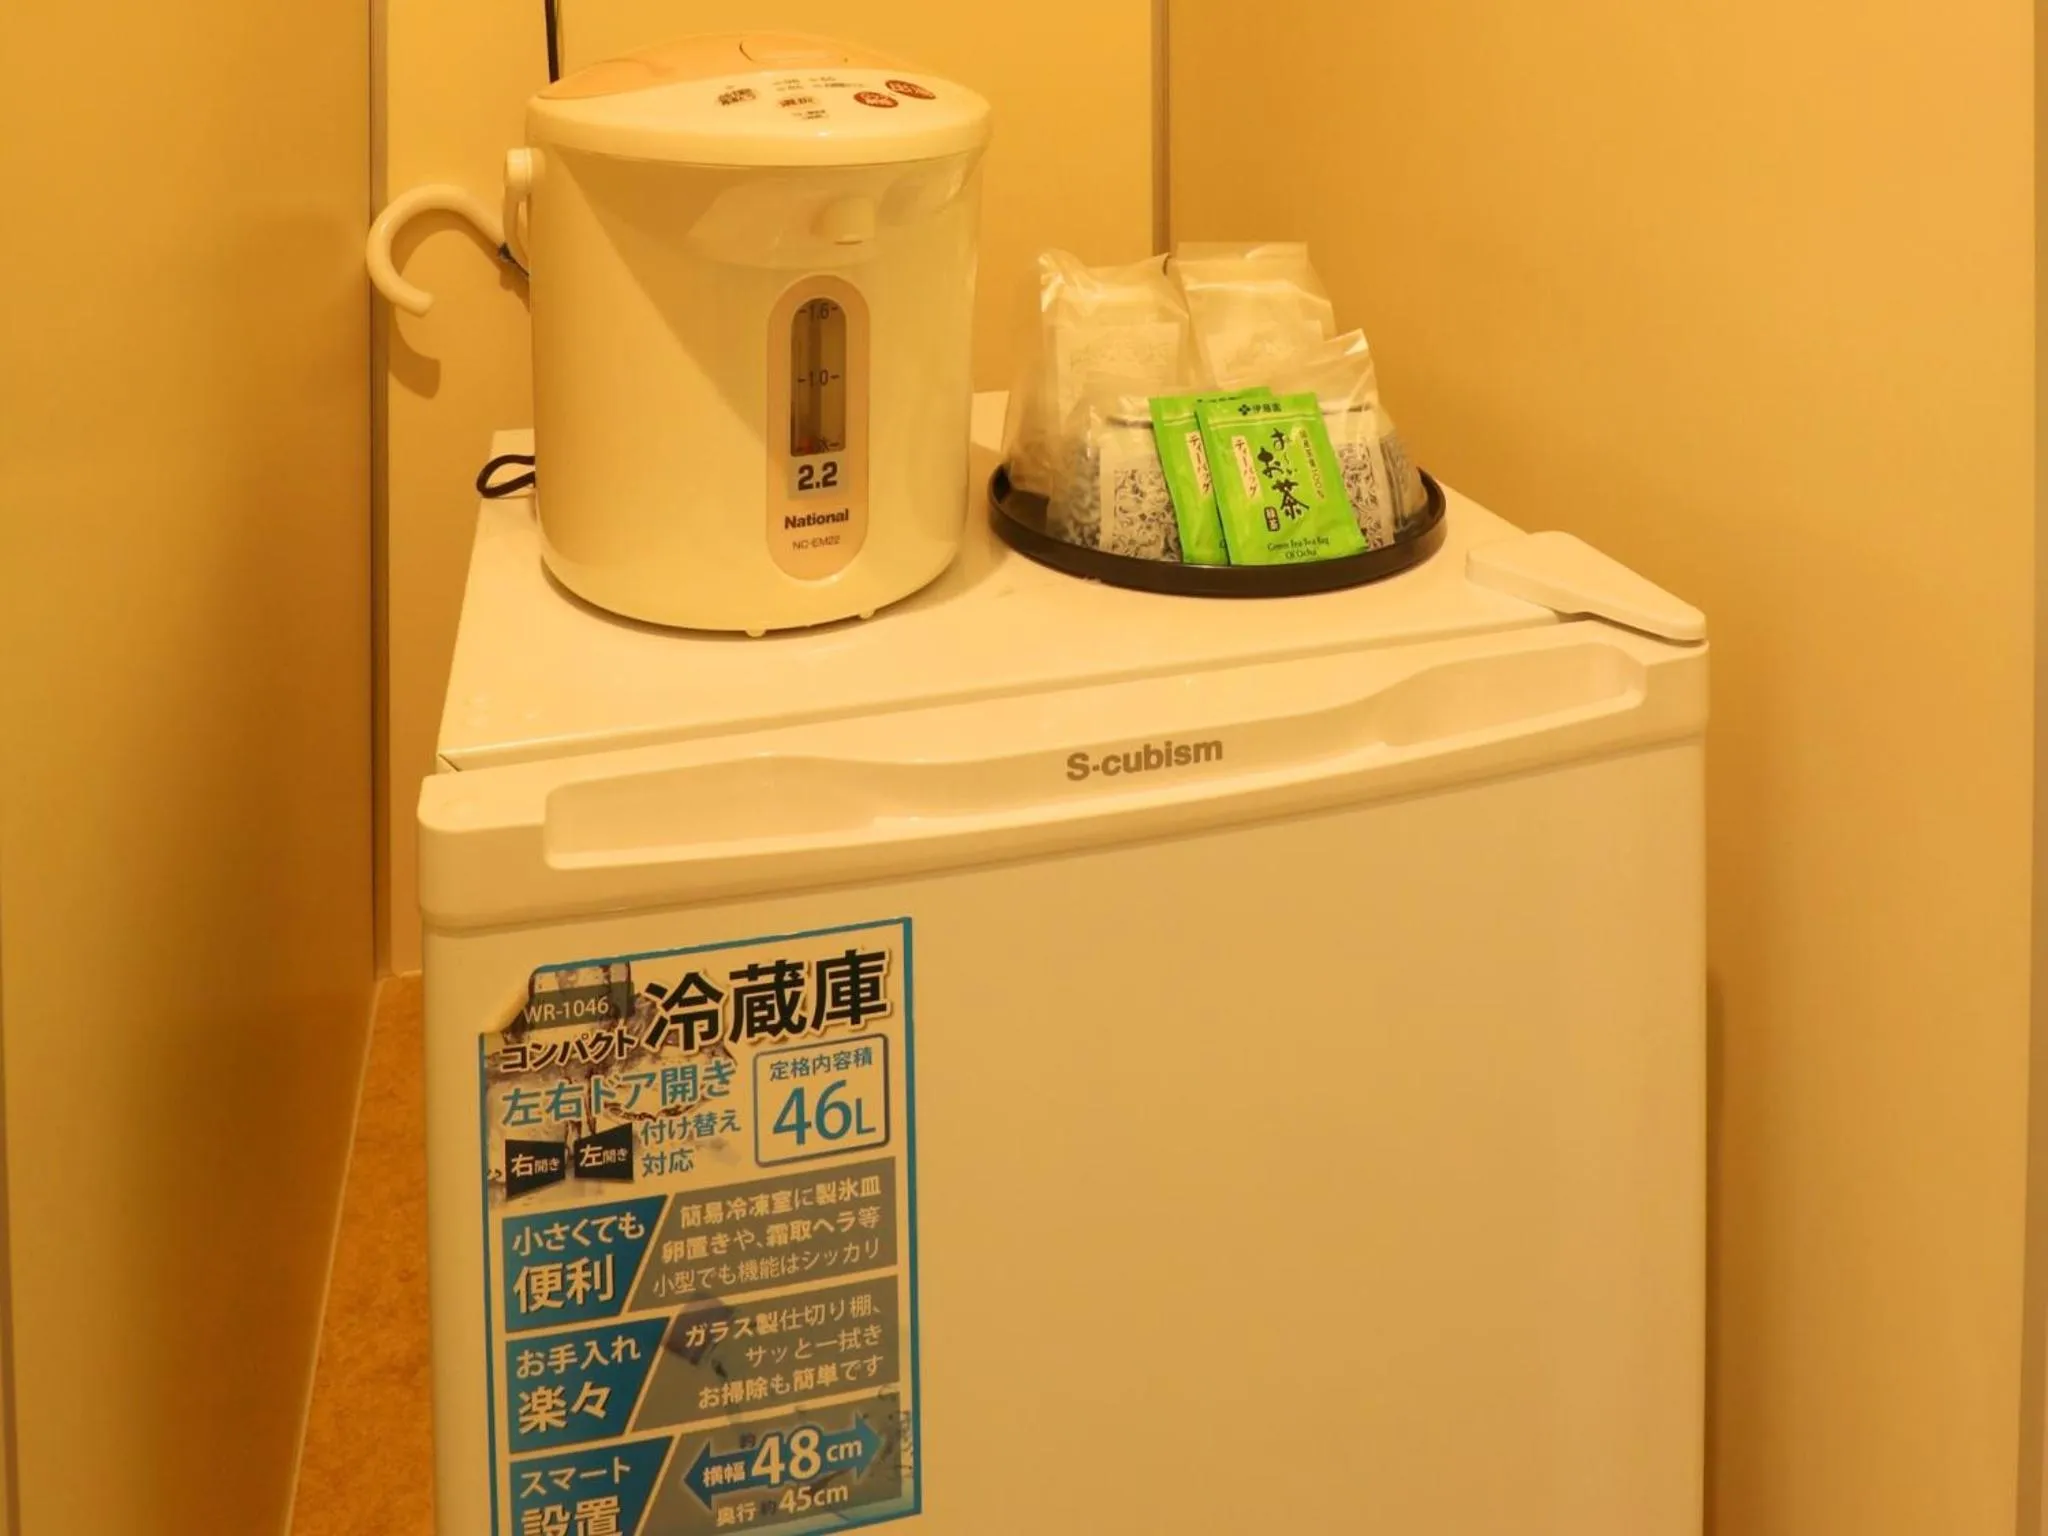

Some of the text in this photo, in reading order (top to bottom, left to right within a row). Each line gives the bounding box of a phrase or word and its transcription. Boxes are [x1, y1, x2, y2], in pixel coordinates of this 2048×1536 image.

[797, 461, 838, 491] 2.2
[784, 508, 849, 529] National
[1066, 741, 1223, 781] S-cubism
[523, 998, 609, 1024] WR-1046
[644, 950, 889, 1052] 冷蔵庫
[501, 1030, 637, 1072] コンパクト
[770, 1047, 872, 1081] 定格内容積
[502, 1060, 737, 1127] 左右ドア開き
[641, 1109, 741, 1145] 付け替え
[511, 1154, 560, 1178] 右開き
[579, 1144, 628, 1168] 左開き
[642, 1149, 694, 1178] 対応
[680, 1175, 881, 1229] 簡易冷凍室に製氷皿
[512, 1212, 645, 1256] 小さくても
[513, 1254, 615, 1314] 便利
[653, 1238, 880, 1298] 小型でも機能はシッカリ
[516, 1335, 641, 1379] お手入れ
[746, 1324, 883, 1368] サッと一拭き
[698, 1354, 884, 1409] お掃除も簡単です
[518, 1381, 611, 1435] 楽々
[520, 1456, 631, 1498] スマート
[703, 1461, 746, 1488] 横幅
[521, 1495, 624, 1536] 設置
[716, 1502, 757, 1527] 奥行
[778, 1484, 849, 1514] 45cm
